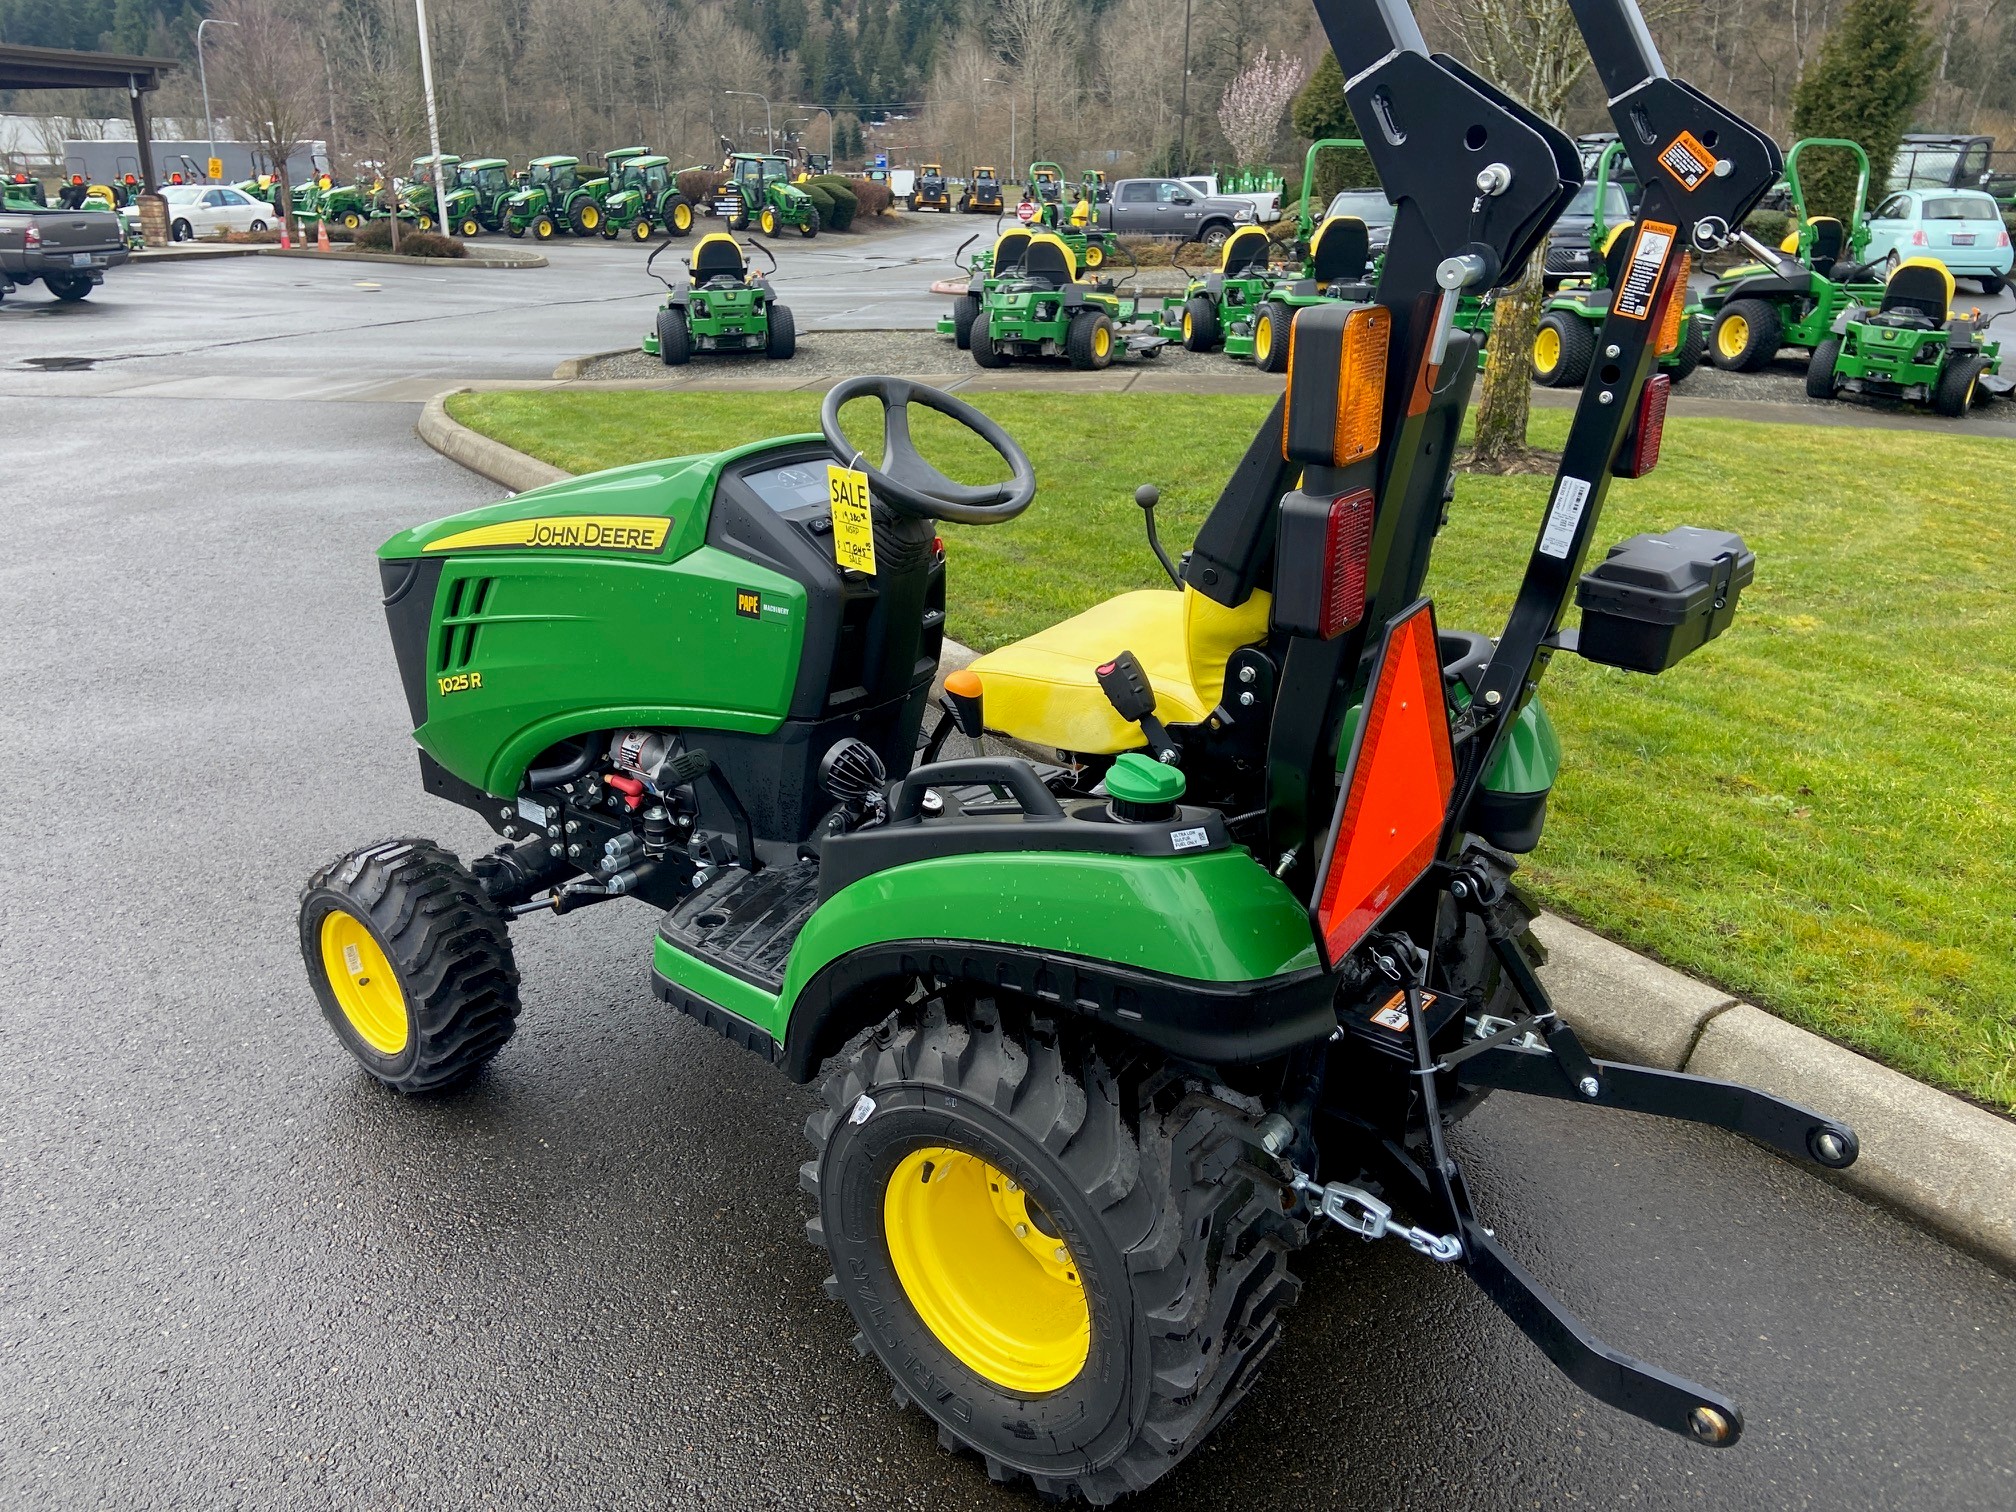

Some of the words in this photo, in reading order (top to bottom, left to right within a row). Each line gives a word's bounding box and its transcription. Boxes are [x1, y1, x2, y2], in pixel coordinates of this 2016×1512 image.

[1687, 142, 1713, 168] WARNING
[1649, 223, 1674, 235] WARNING
[832, 479, 867, 510] SALE
[526, 523, 580, 543] JOHN
[584, 523, 655, 547] DEERE
[849, 554, 863, 566] SALE
[763, 603, 789, 616] MACHINERY
